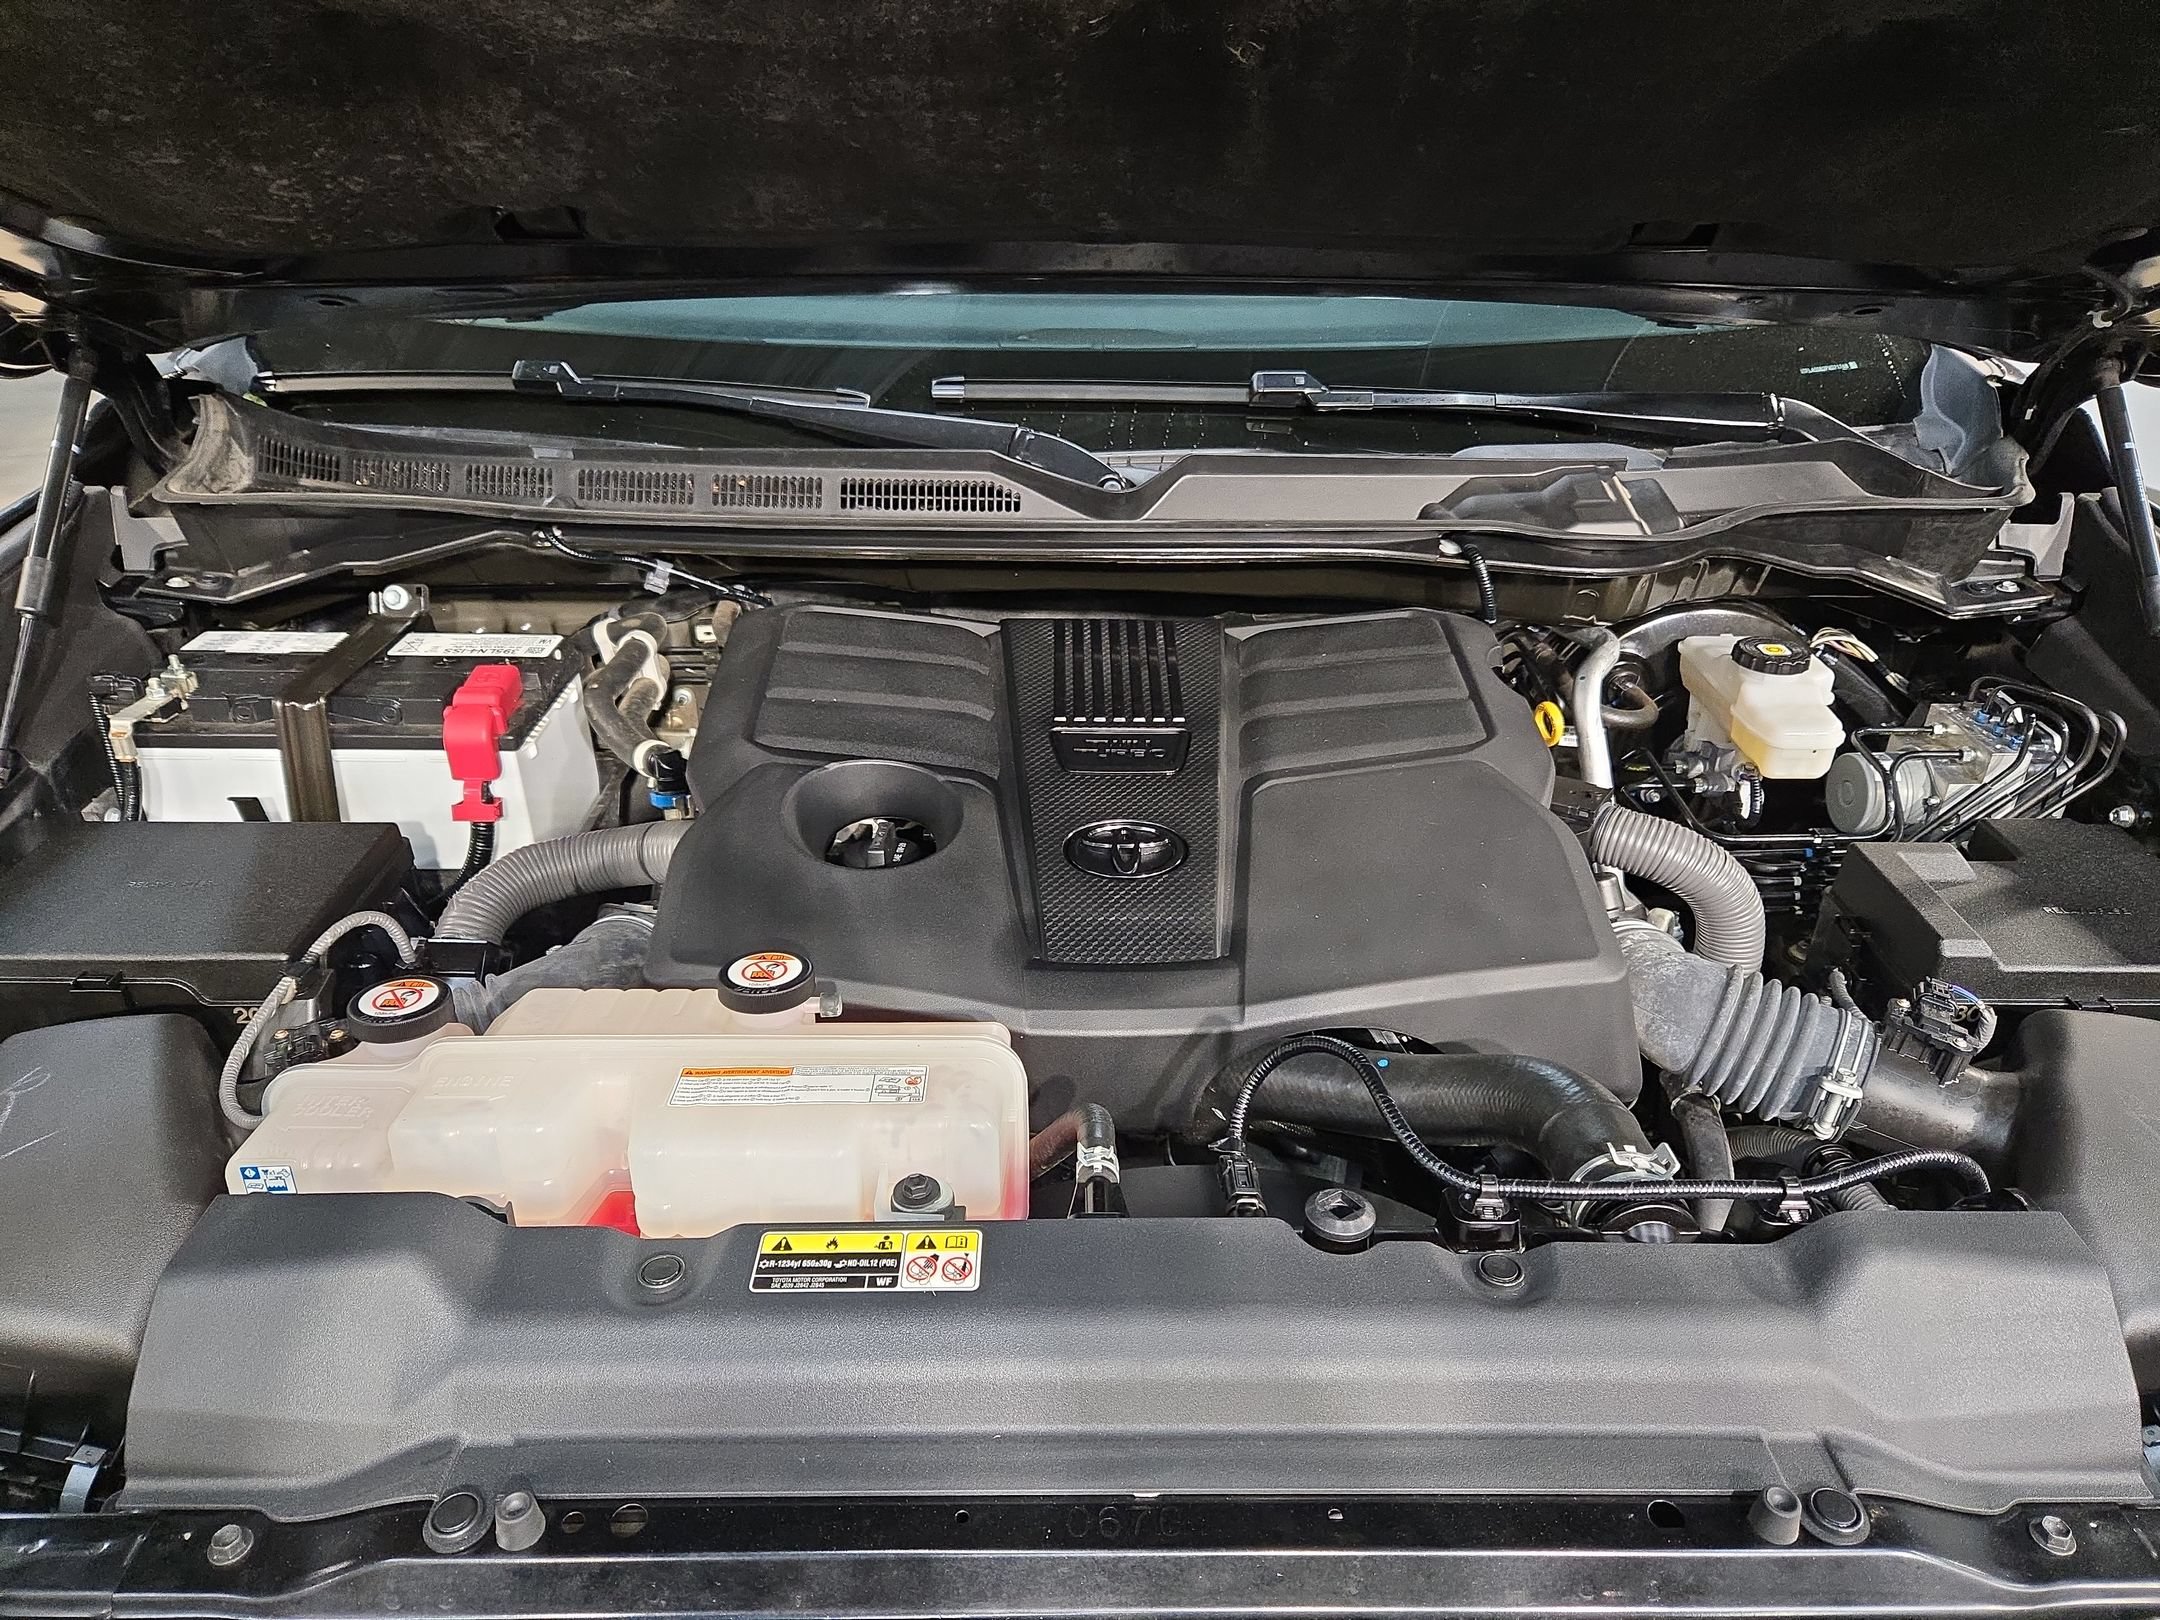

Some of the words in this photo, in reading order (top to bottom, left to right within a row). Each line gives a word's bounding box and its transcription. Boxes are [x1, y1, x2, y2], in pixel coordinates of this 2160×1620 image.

[769, 1259, 801, 1269] R-1234yf
[879, 1259, 898, 1269] (POE)
[876, 1276, 893, 1287] WF
